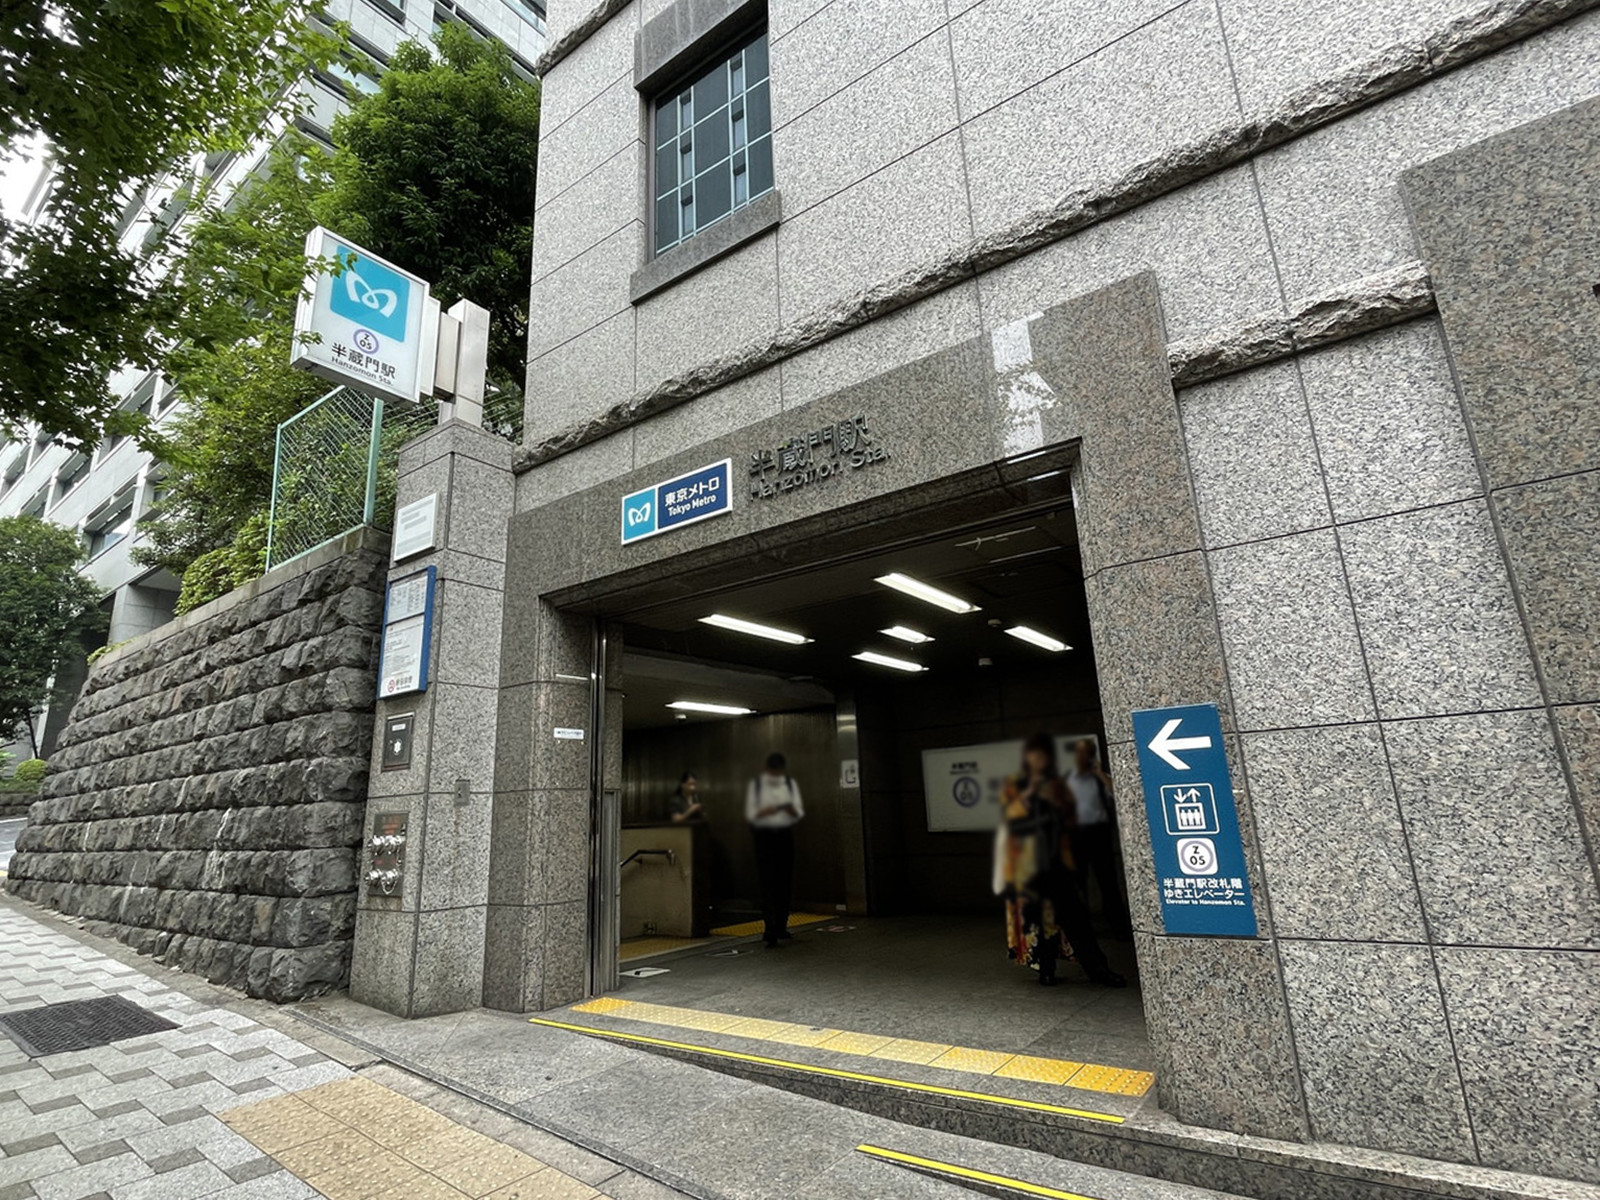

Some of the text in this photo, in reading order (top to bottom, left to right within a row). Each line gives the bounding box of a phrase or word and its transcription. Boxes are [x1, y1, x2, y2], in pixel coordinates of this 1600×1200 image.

[359, 340, 372, 350] 05
[363, 333, 370, 341] Z
[331, 342, 396, 379] 半蔵門駅
[331, 356, 393, 386] Hanzomon Sta.
[749, 413, 872, 480] 半蔵門駅
[850, 447, 891, 469] Sta.
[665, 476, 720, 507] 東京メトロ
[667, 494, 717, 517] Tokyo Metro
[1192, 845, 1200, 854] Z
[1189, 855, 1206, 866] 05
[1163, 878, 1243, 889] 半蔵門駅改札階
[1163, 889, 1245, 899] ゆきエレベーター
